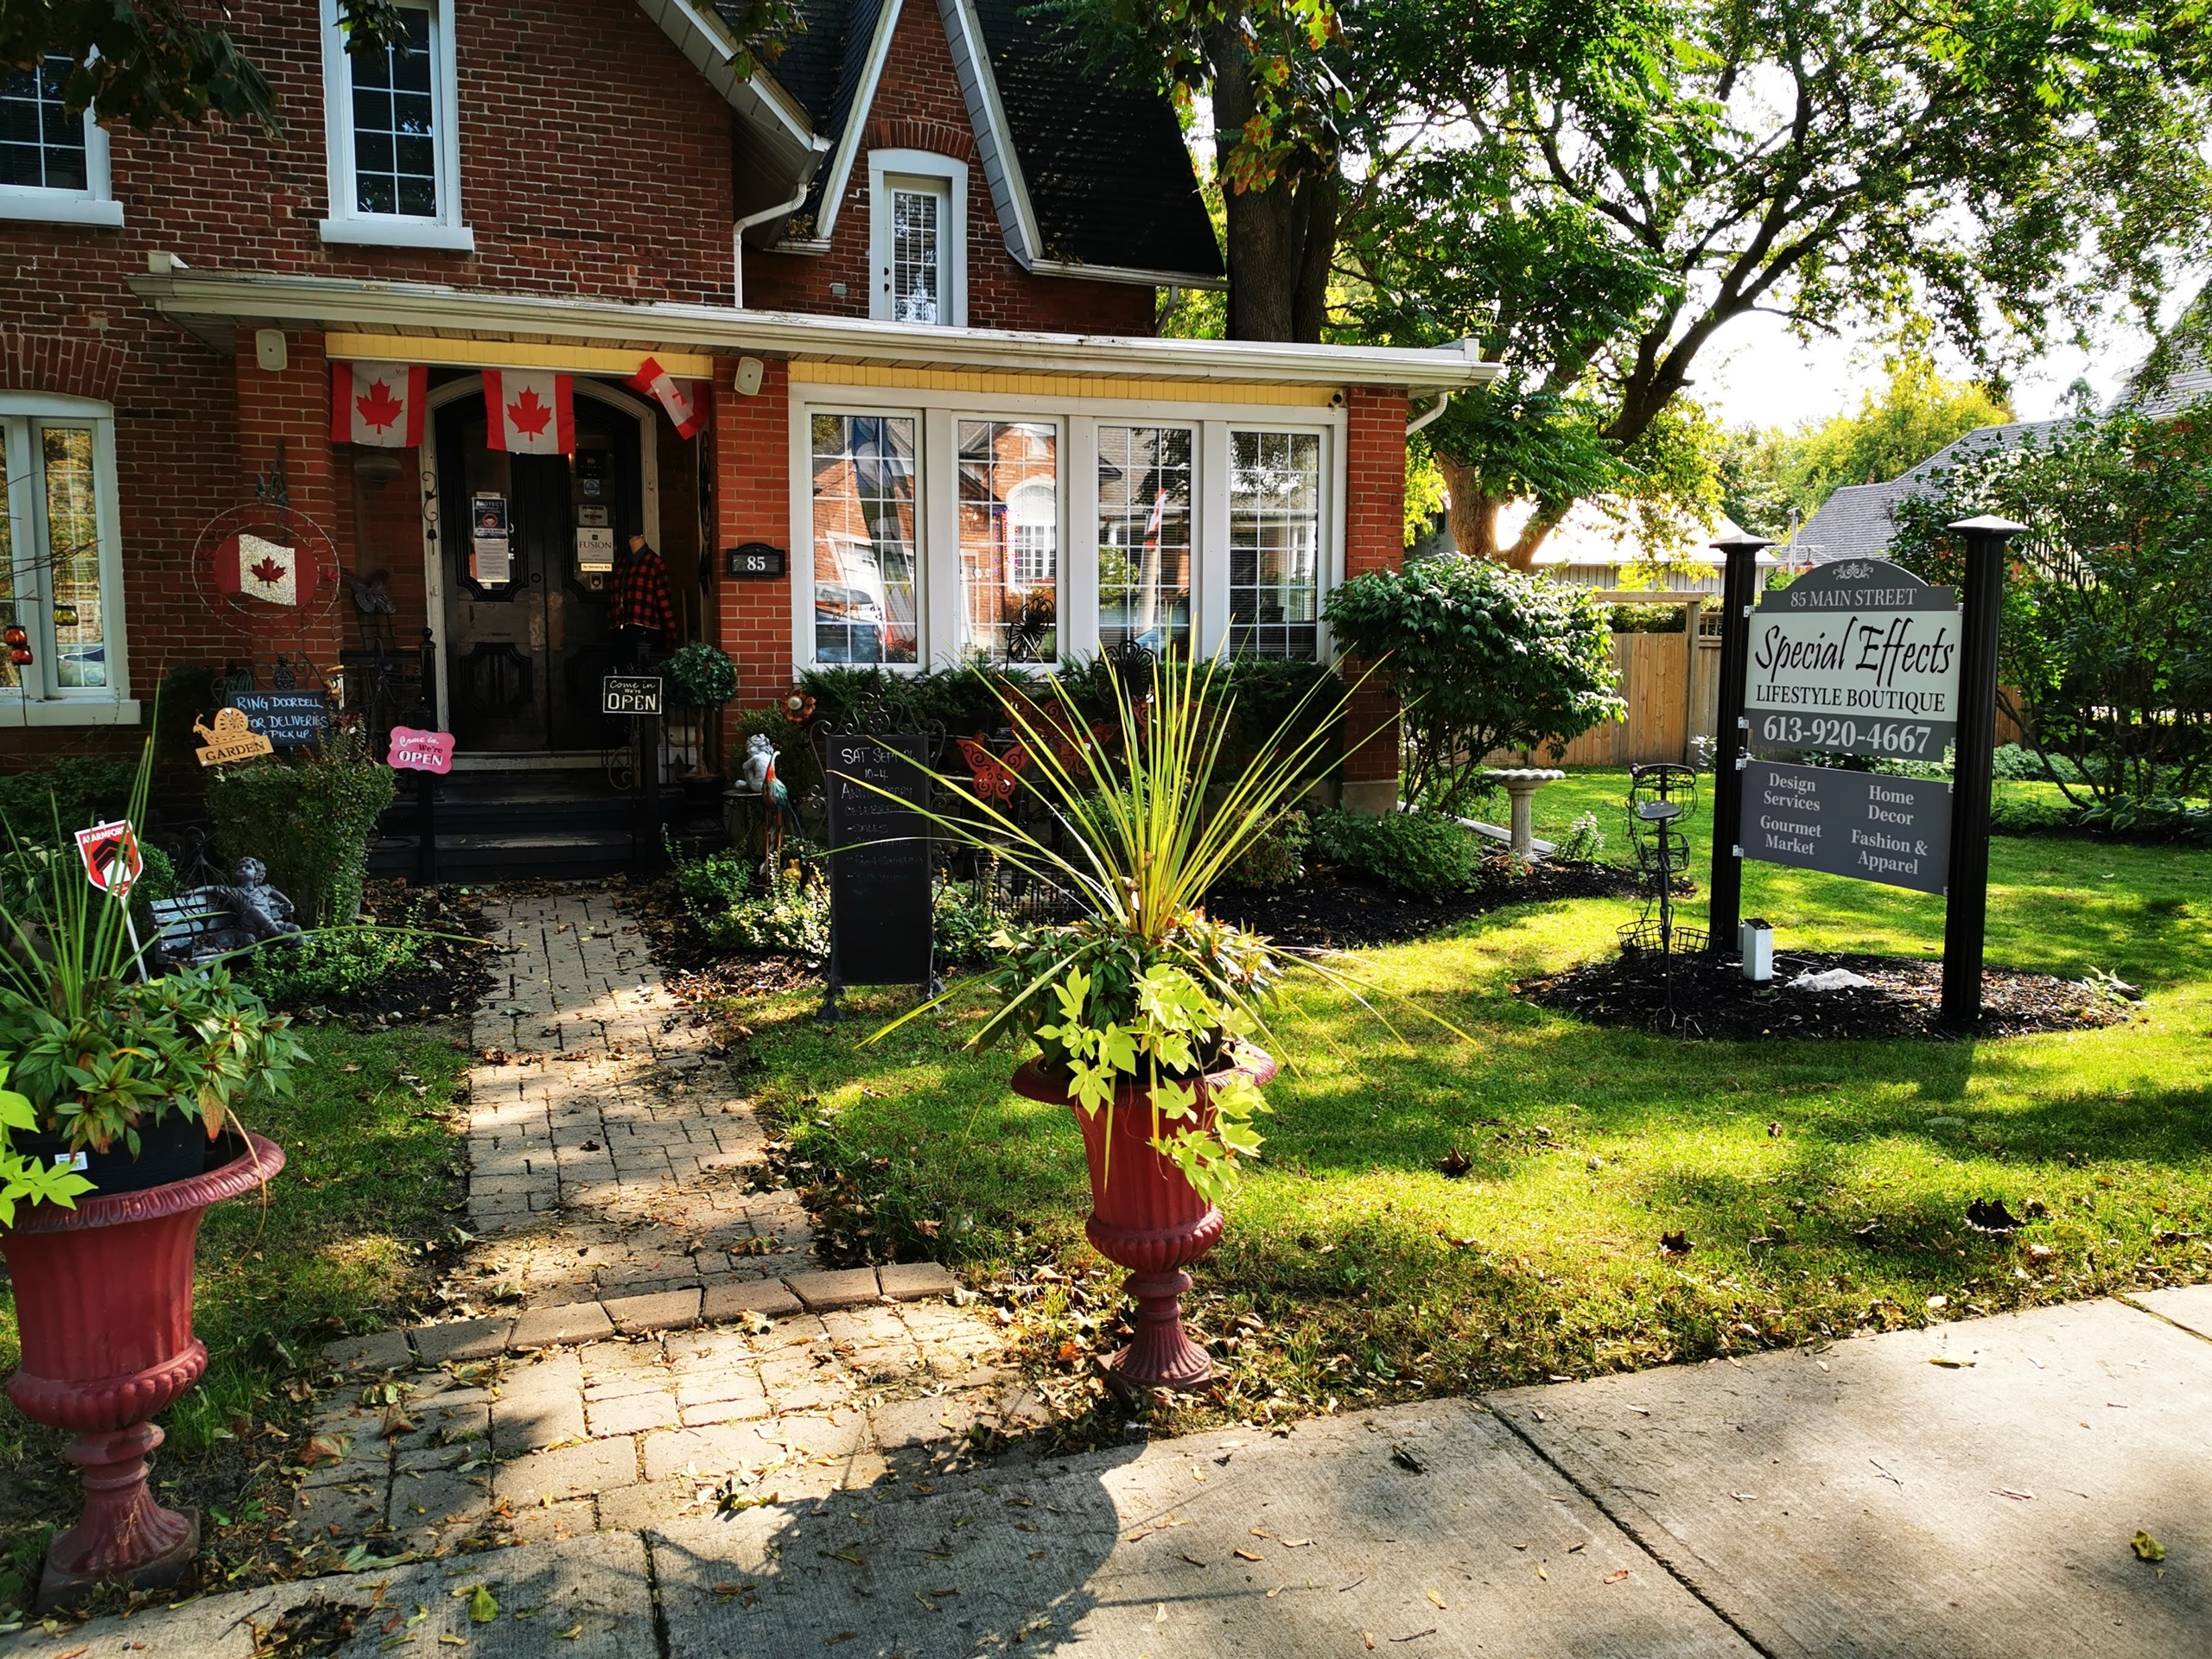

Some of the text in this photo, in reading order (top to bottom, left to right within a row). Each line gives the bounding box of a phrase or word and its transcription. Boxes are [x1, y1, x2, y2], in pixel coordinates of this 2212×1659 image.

[747, 556, 766, 570] 85
[1790, 588, 1917, 607] 85 MAIN STREET
[1755, 616, 1955, 688] Special Effects
[609, 679, 656, 689] Come in
[236, 696, 324, 710] RING DOORBELL
[607, 693, 656, 710] OPEN
[1756, 684, 1946, 715] LIFESTYLE BOUTIQUE
[246, 715, 329, 728] FOR DELIVERIES
[267, 730, 295, 739] PICK
[399, 735, 424, 747] Come
[1764, 715, 1932, 753] 613-920-4667
[206, 741, 266, 761] GARDEN
[398, 750, 443, 766] OPEN
[419, 744, 443, 753] We're
[841, 747, 870, 765] SAT
[865, 768, 888, 781] 10-4
[1769, 772, 1816, 795] Design
[1764, 791, 1821, 811] Services
[1868, 785, 1915, 805] Home
[1867, 804, 1914, 825] Decor
[1760, 815, 1822, 838] Gourmet
[1764, 834, 1815, 855] Market
[1851, 829, 1928, 856] Fashion &
[1857, 850, 1919, 874] Apparel
